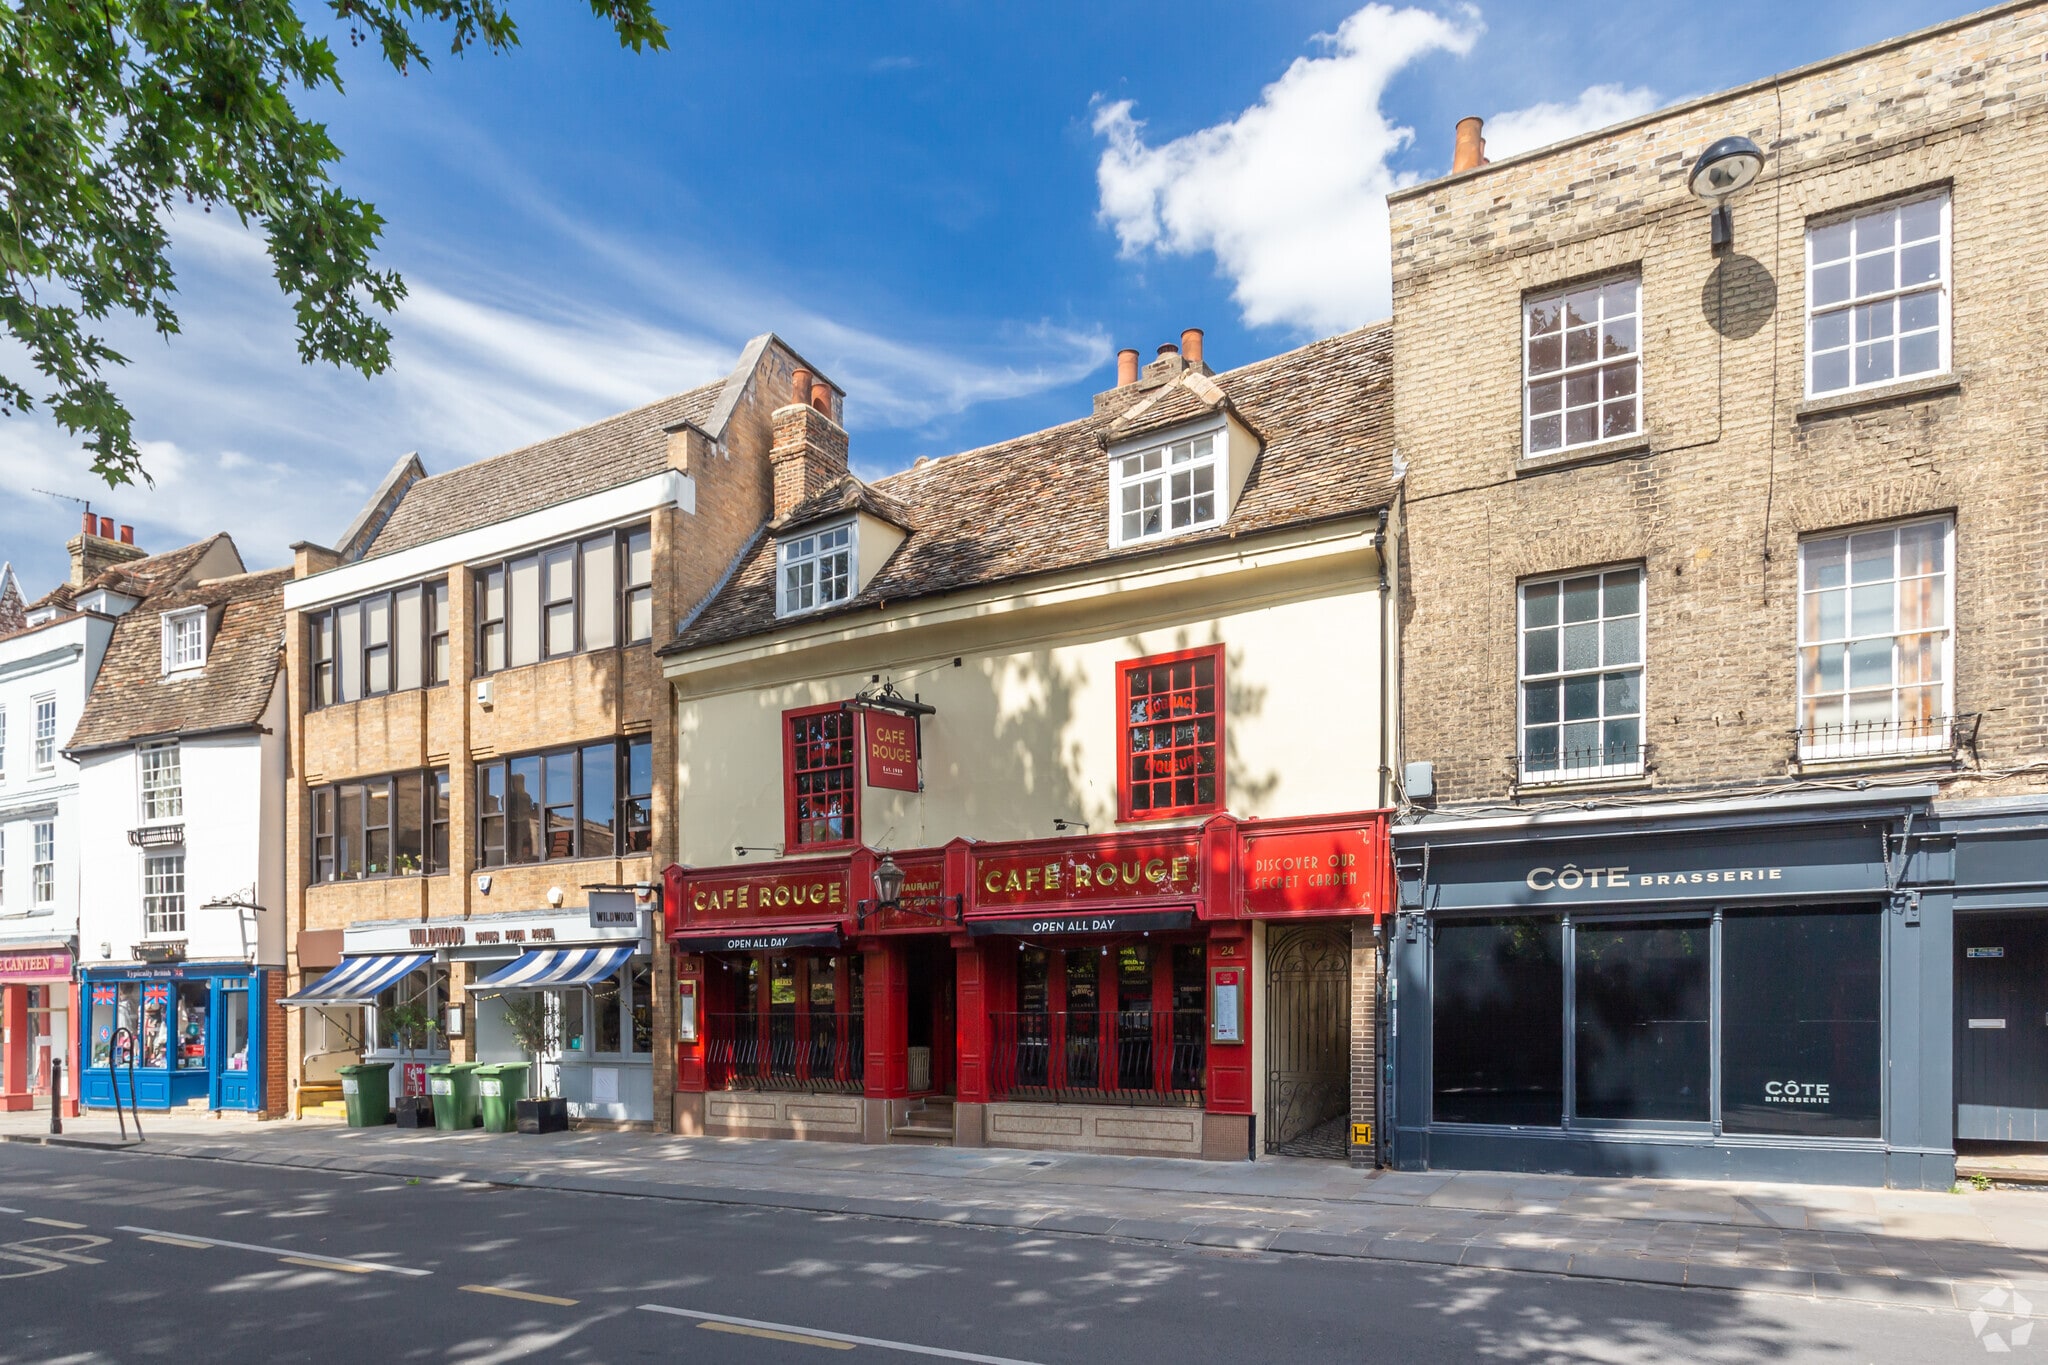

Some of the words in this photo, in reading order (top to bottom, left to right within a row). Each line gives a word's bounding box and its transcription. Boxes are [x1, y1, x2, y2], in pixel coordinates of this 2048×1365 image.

[872, 743, 911, 763] ROUGE
[1256, 856, 1318, 872] DISCOVER
[1328, 853, 1355, 868] OUR
[1075, 856, 1189, 888] ROUGE
[1526, 863, 1630, 891] CÔTE
[1640, 868, 1782, 886] BRASSERIE
[1255, 875, 1298, 890] SECRET
[1308, 871, 1357, 887] GARDEN
[758, 882, 841, 907] ROUGE
[596, 911, 634, 922] WILDWOOD
[1032, 921, 1064, 932] OPEN
[1067, 920, 1089, 931] ALL
[1092, 919, 1116, 930] DAY
[409, 926, 465, 946] WILDWOOD
[727, 939, 750, 949] OPEN
[753, 938, 769, 948] ALL
[770, 937, 789, 947] DAY
[1221, 946, 1234, 956] 24
[4, 956, 50, 972] CANTEEN
[127, 970, 152, 978] Typically
[153, 969, 171, 977] British
[1765, 1080, 1829, 1096] CÔTE
[1764, 1096, 1830, 1104] BRASSERIE
[1354, 1126, 1368, 1143] H
